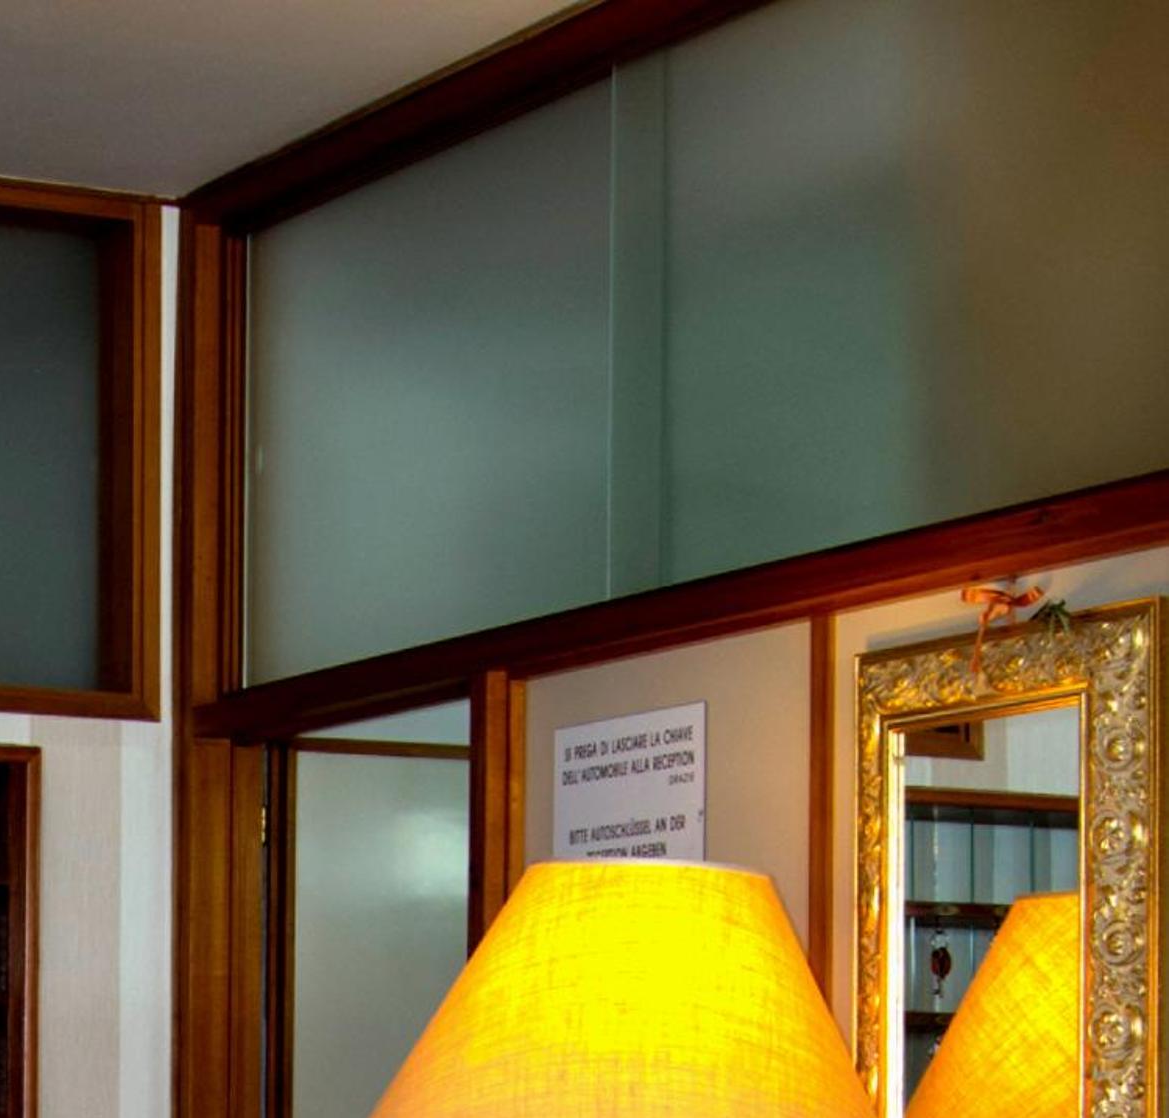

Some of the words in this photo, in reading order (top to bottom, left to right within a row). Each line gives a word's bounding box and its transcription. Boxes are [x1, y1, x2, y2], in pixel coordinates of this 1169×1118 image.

[574, 741, 597, 760] PREGA
[601, 740, 609, 756] DI
[612, 733, 647, 754] LASCIARE
[651, 731, 661, 748] LA
[663, 725, 694, 744] CHIAVE
[631, 757, 650, 774] ALLA
[652, 750, 695, 770] RECEPTION
[569, 828, 588, 846] BITTE
[655, 817, 667, 831] AN
[670, 814, 685, 831] DER
